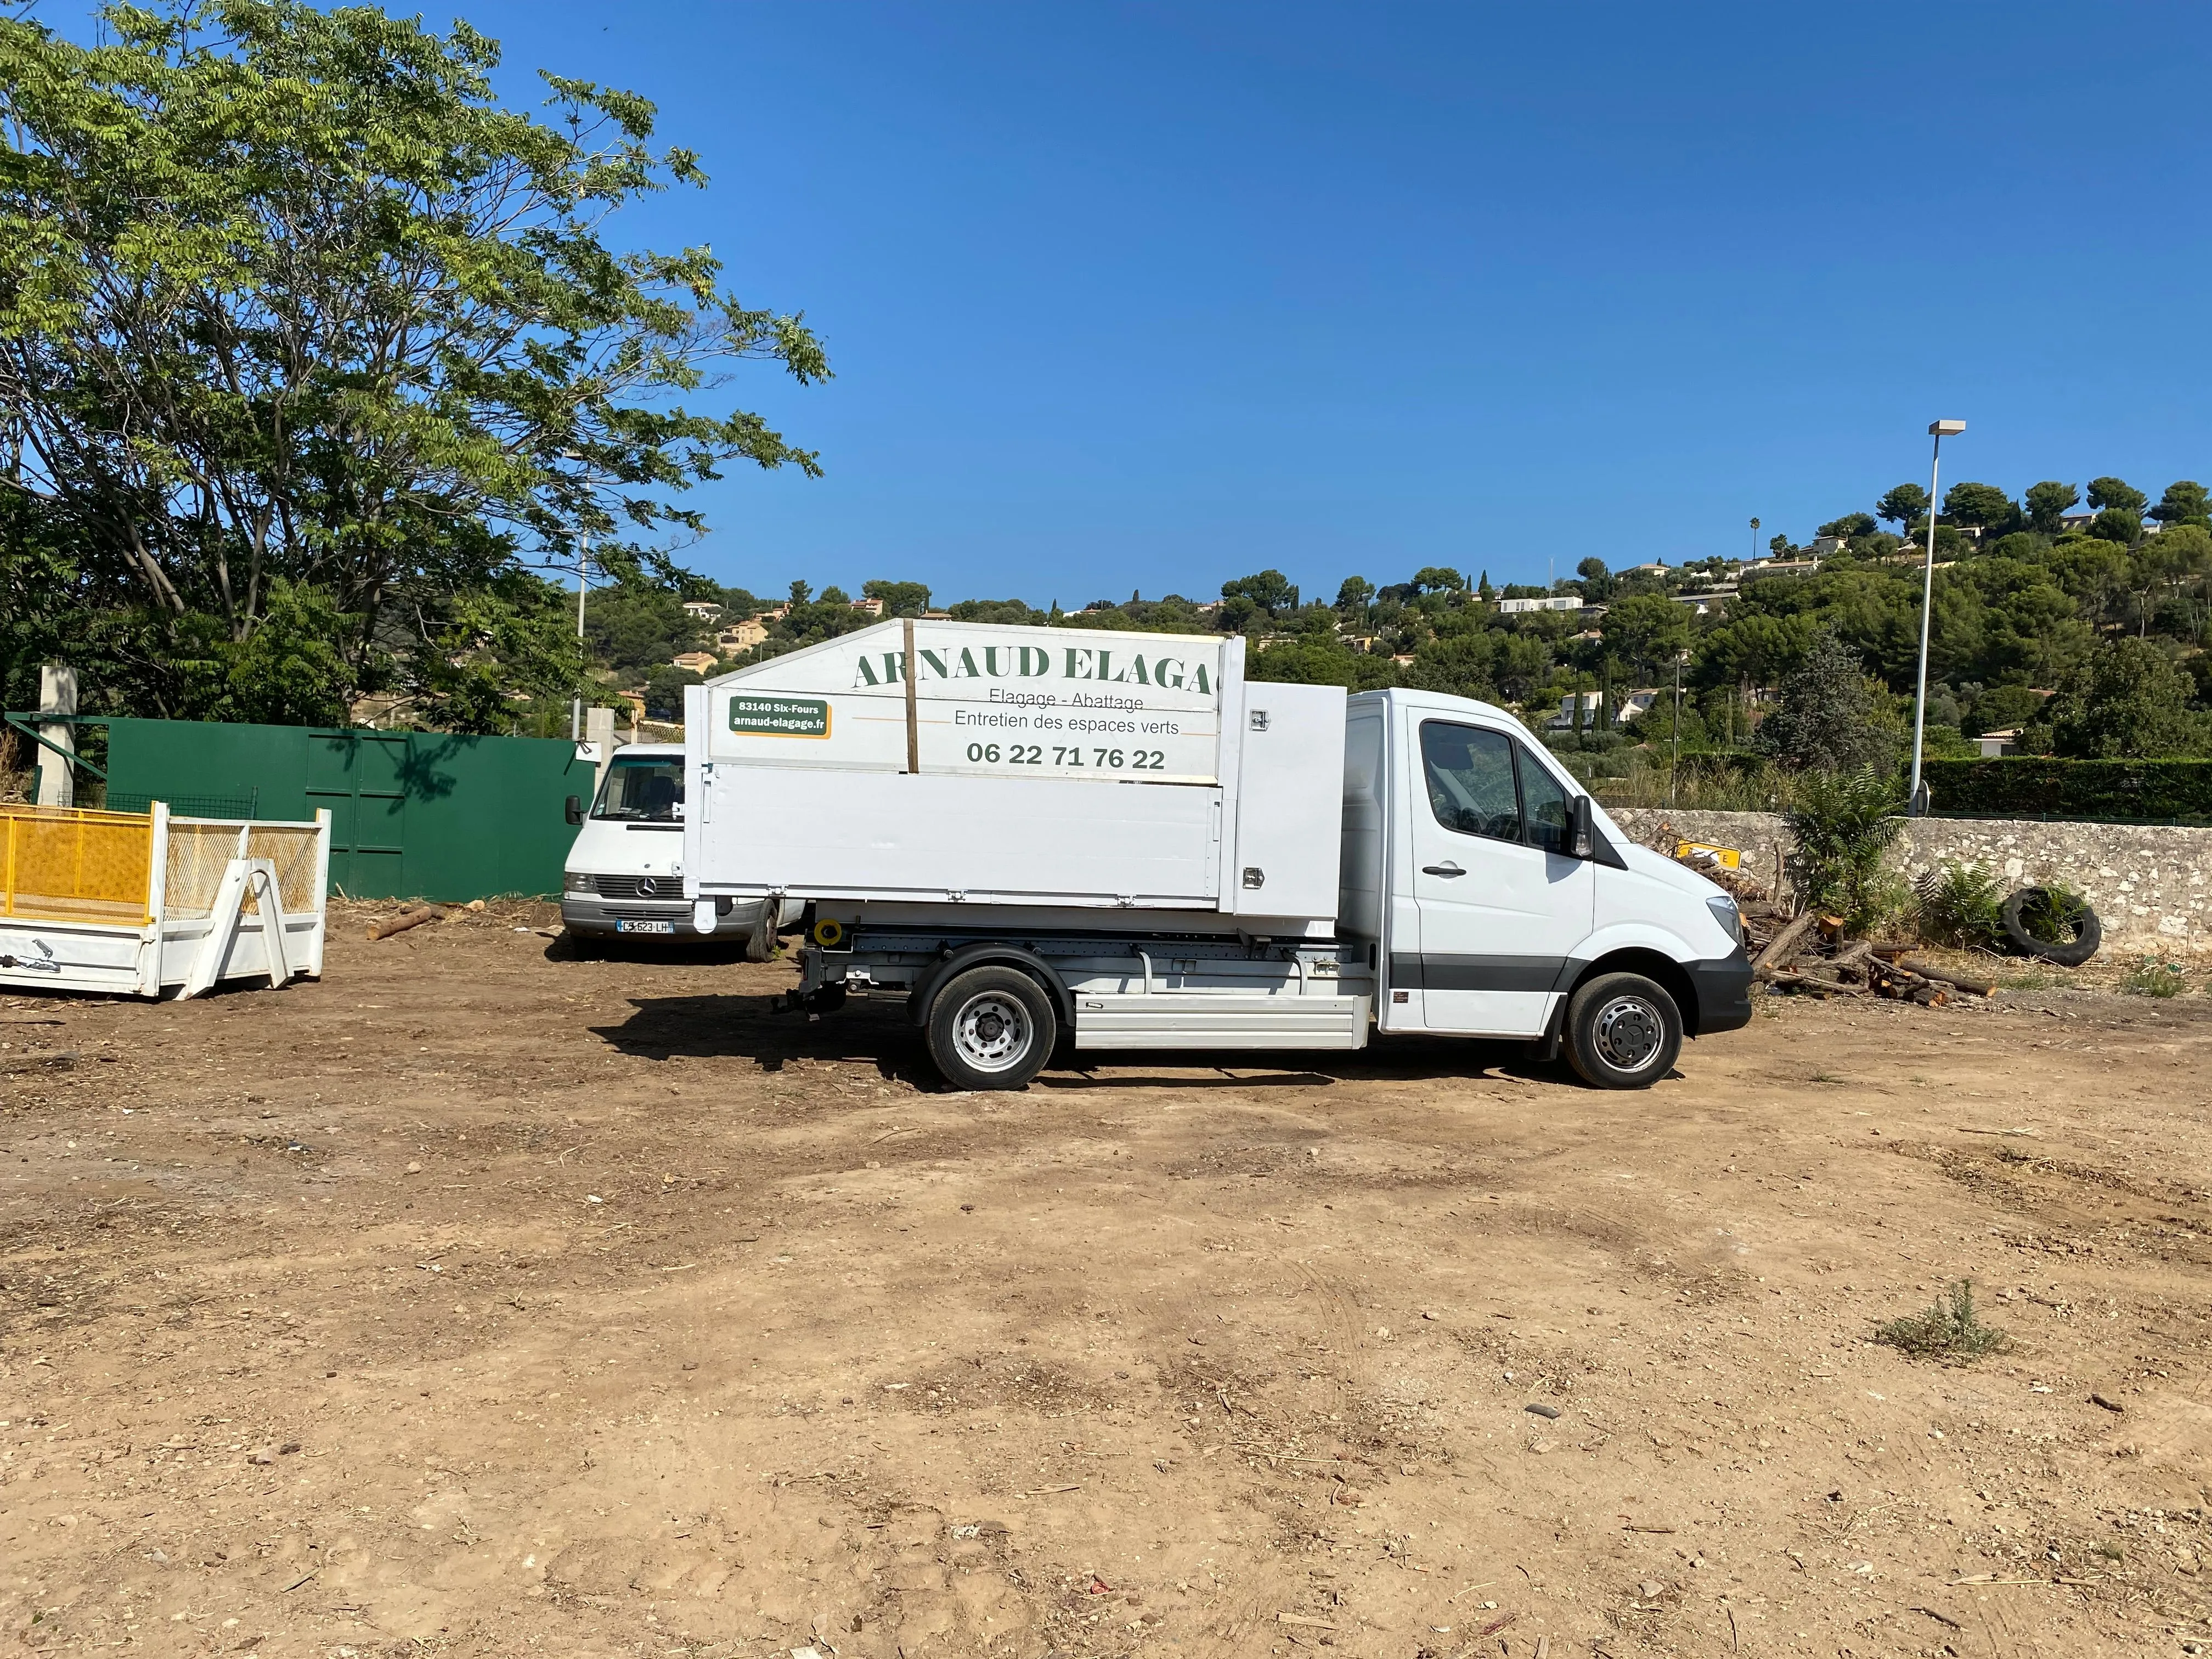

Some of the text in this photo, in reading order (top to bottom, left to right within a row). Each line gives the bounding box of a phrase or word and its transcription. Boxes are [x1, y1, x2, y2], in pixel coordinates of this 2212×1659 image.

[851, 646, 1219, 696] ARNAUD ELAGA
[738, 702, 819, 714] 83140 Six-Fours
[990, 688, 1056, 709] Elagage
[1071, 692, 1143, 714] Abattage
[733, 716, 825, 730] arnaud-elagage.fr
[955, 710, 1179, 735] Entretien des espaces verts
[967, 743, 1165, 770] 06 22 71 76 22
